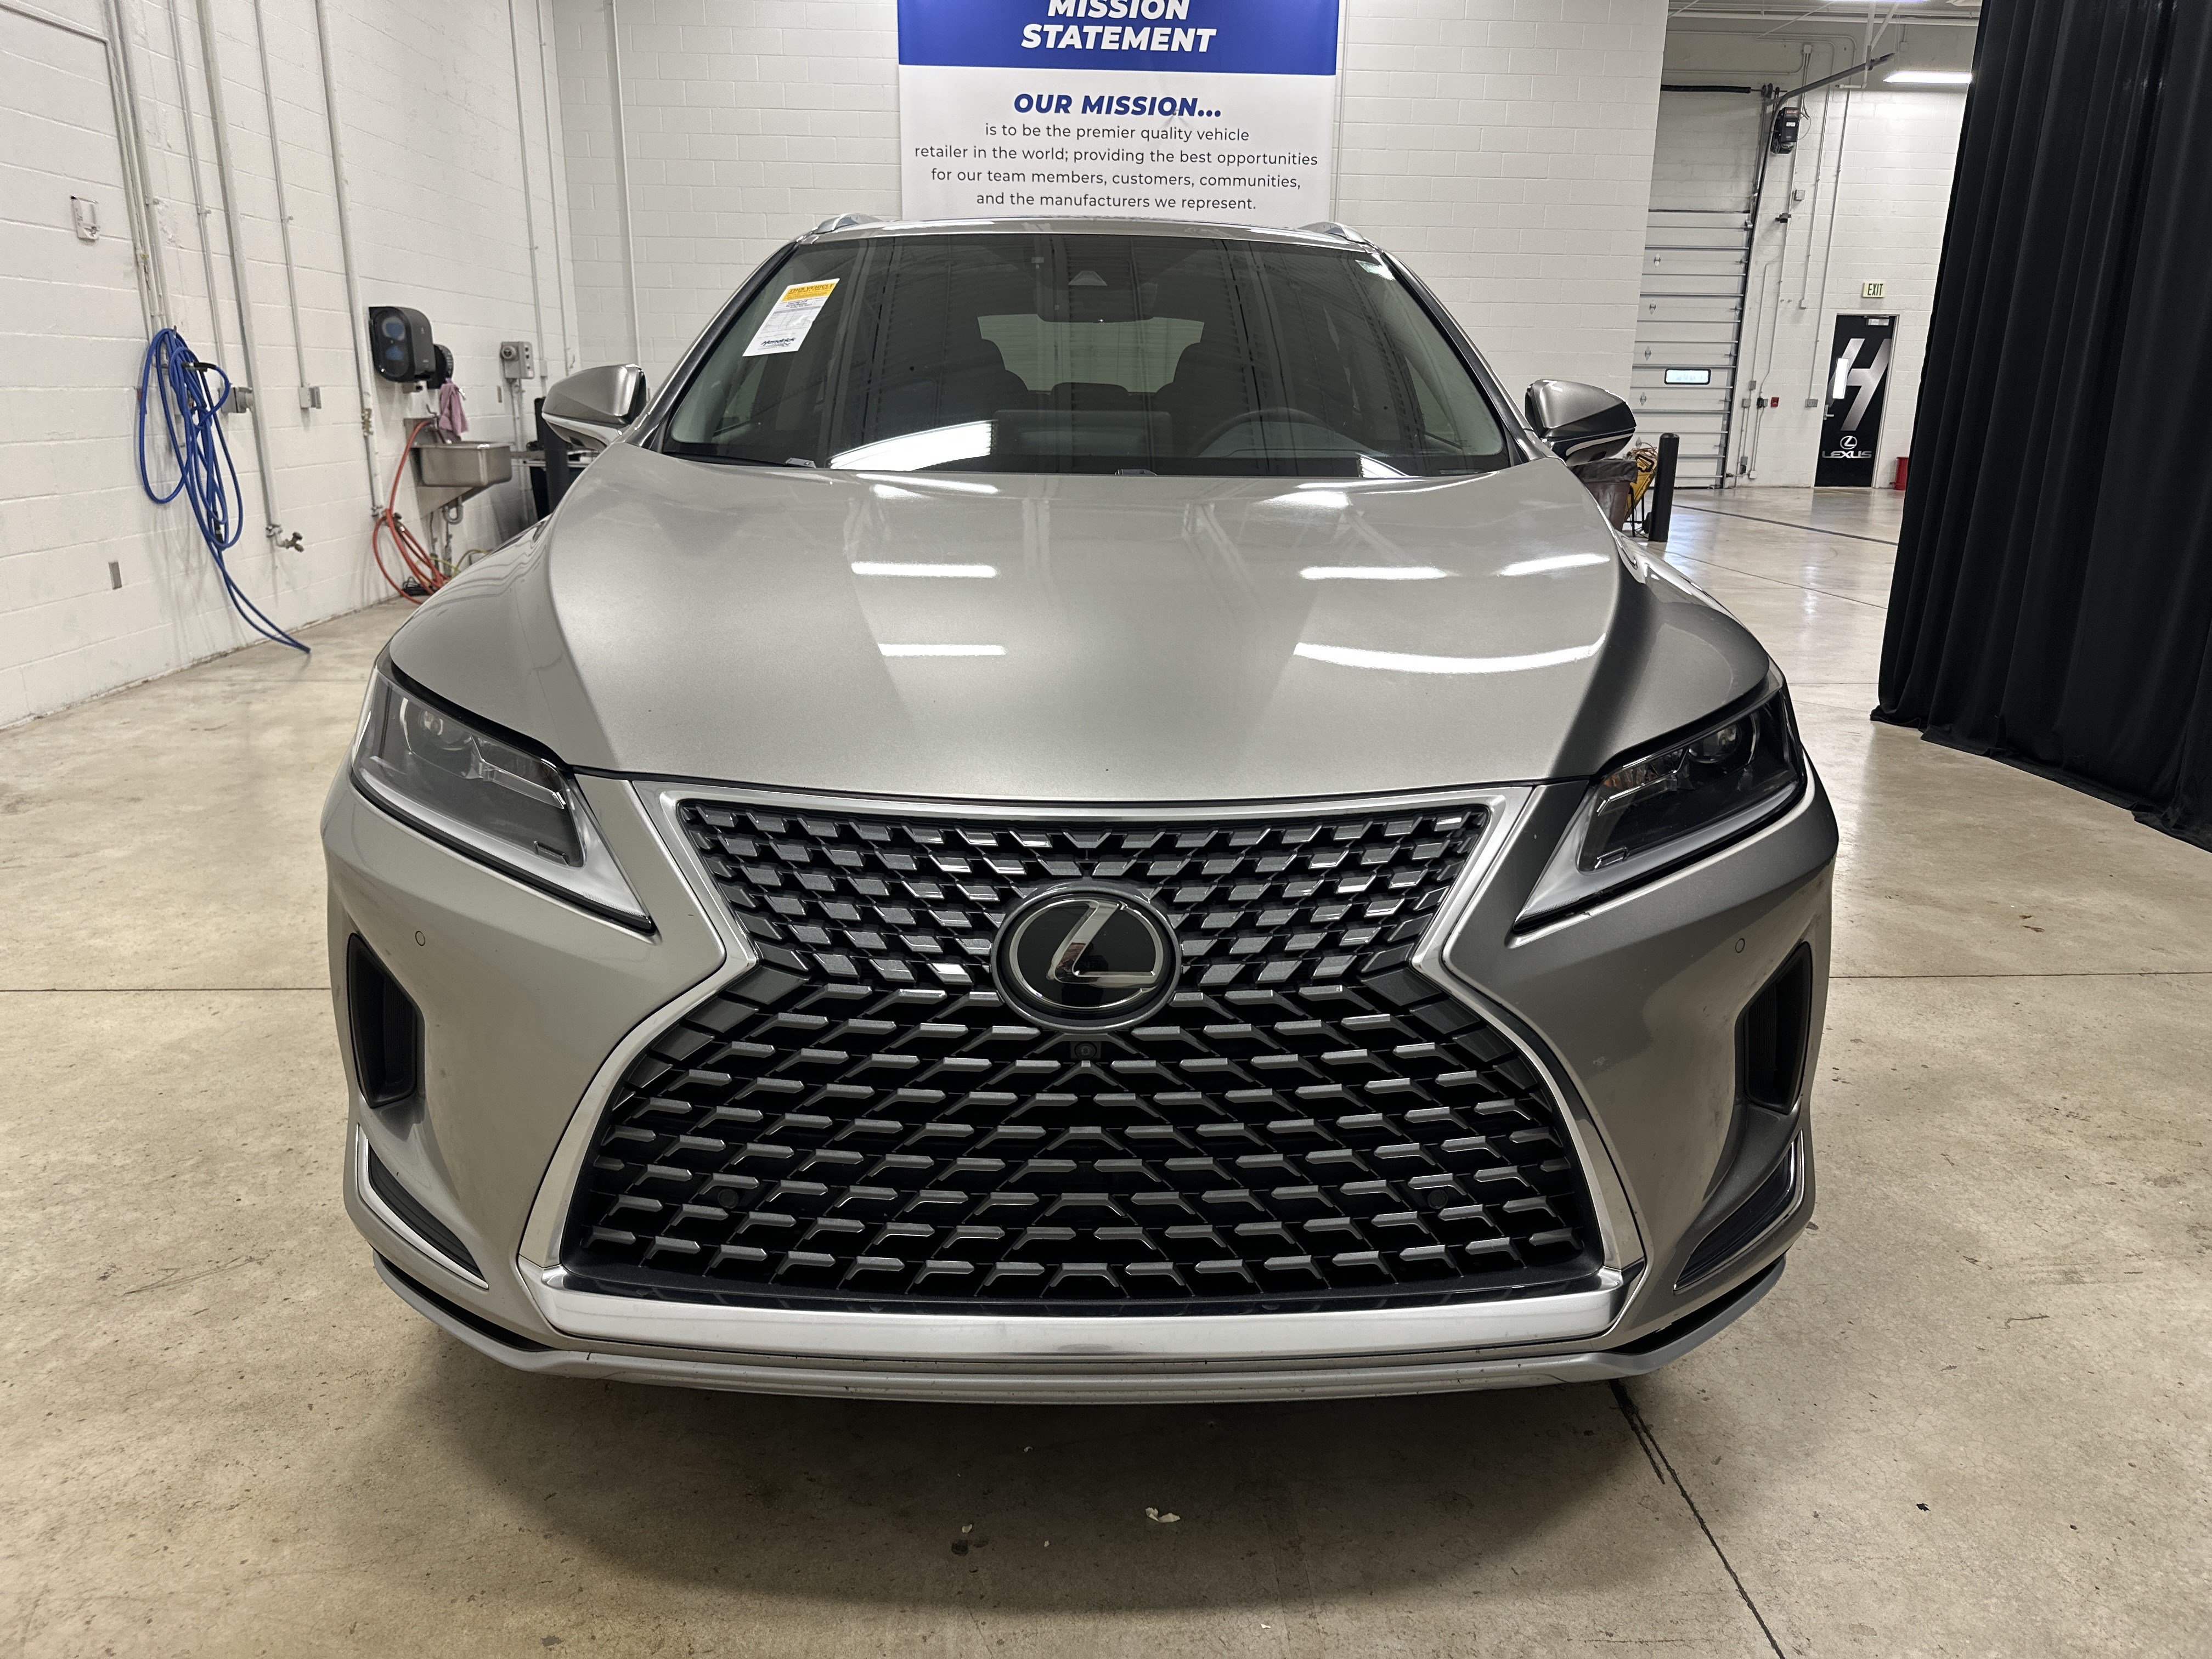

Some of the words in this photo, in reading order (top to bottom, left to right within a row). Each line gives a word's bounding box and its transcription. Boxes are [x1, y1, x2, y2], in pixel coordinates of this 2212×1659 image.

[1047, 0, 1190, 20] MISSION
[1021, 24, 1217, 52] STATEMENT
[1014, 93, 1073, 114] OUR
[1081, 95, 1221, 117] MISSION...
[985, 122, 997, 136] is
[1002, 125, 1017, 136] to
[1023, 123, 1041, 137] be
[1046, 124, 1071, 137] the
[1077, 125, 1136, 140] premier
[1141, 127, 1193, 143] quality
[1197, 128, 1249, 141] vehicle
[915, 144, 968, 158] retailer
[974, 145, 986, 159] in
[992, 146, 1017, 159] the
[1022, 147, 1068, 162] world;
[1074, 148, 1144, 165] providing
[1149, 149, 1174, 162] the
[1180, 150, 1212, 163] best
[1217, 152, 1318, 167] opportunities
[931, 168, 952, 180] for
[957, 171, 981, 181] our
[987, 170, 1025, 182] team
[1032, 171, 1107, 186] members,
[1112, 173, 1194, 188] customers,
[1200, 174, 1300, 190] communities,
[977, 192, 1004, 205] and
[1009, 193, 1034, 205] the
[1040, 194, 1150, 207] manufacturers
[1154, 198, 1176, 208] we
[1182, 198, 1256, 211] represent.
[1867, 283, 1883, 296] EXIT
